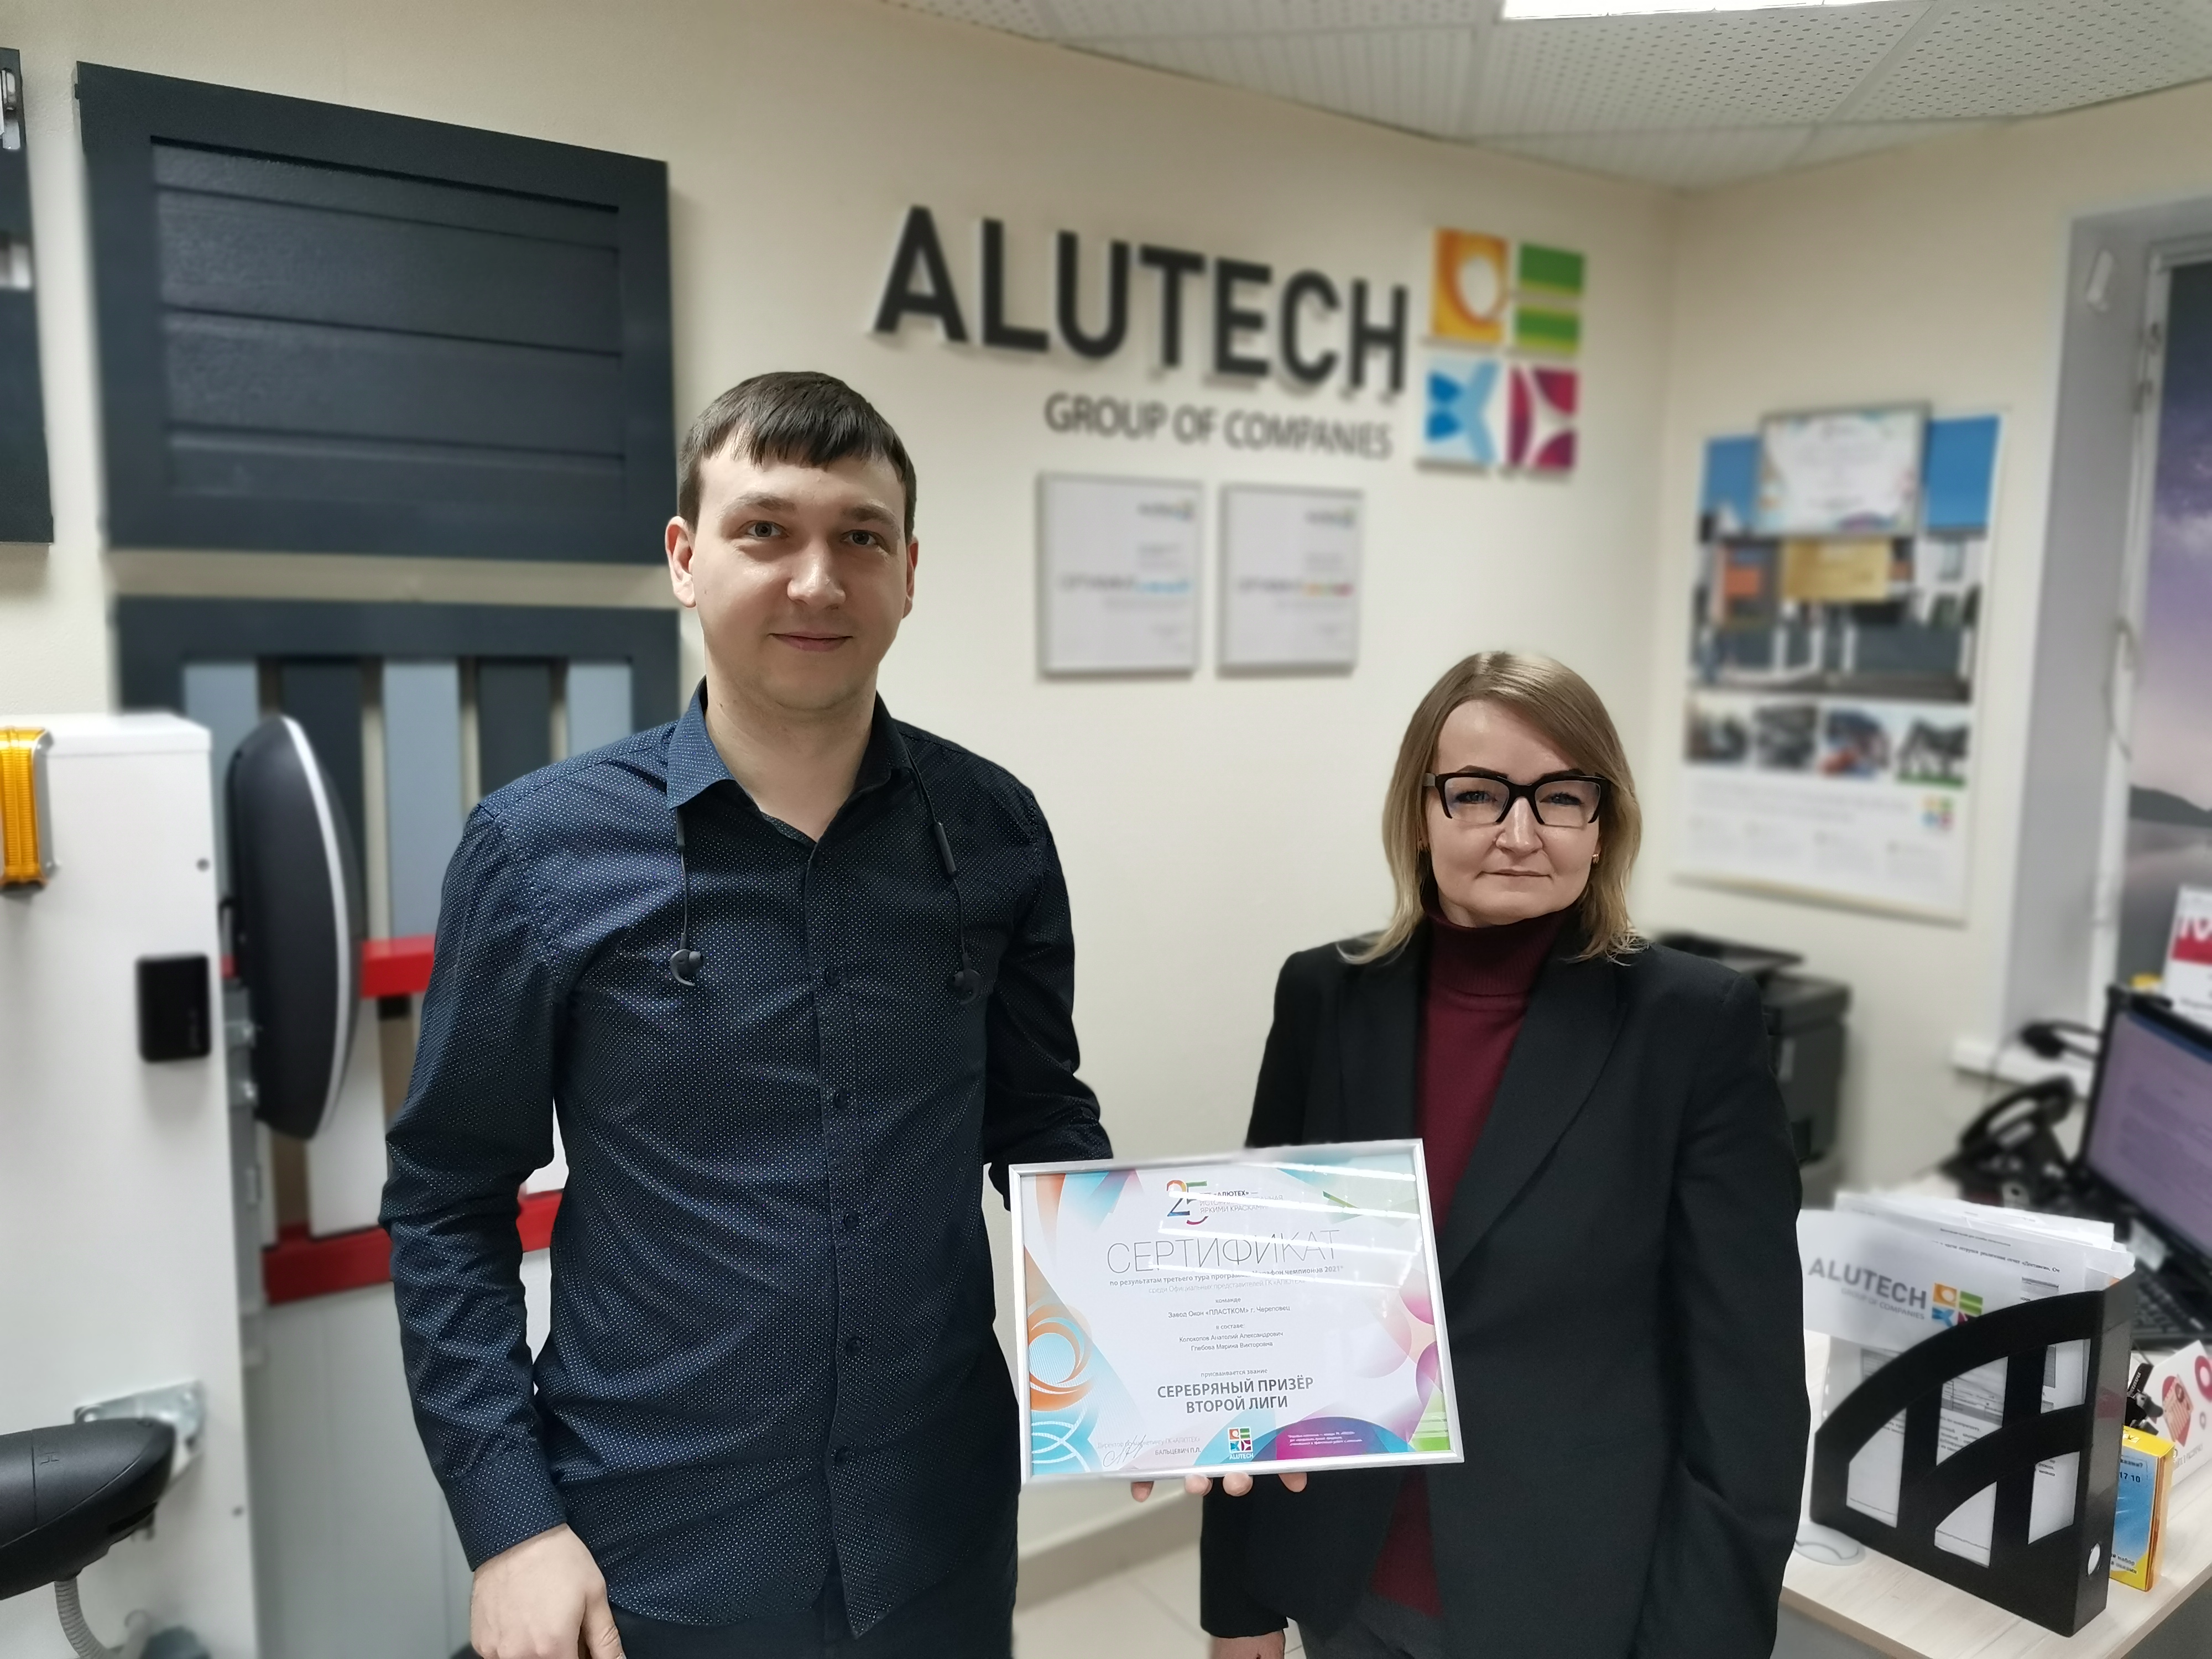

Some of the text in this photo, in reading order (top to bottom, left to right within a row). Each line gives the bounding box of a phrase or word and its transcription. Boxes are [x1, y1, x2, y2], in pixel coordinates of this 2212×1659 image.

[873, 205, 1408, 394] ALUTECH
[1044, 392, 1393, 461] GROUP OF COMPANIES
[1107, 1229, 1340, 1274] СЕРТИФИКАТ
[1120, 1277, 1162, 1287] результатам
[1164, 1275, 1193, 1284] третьего
[1168, 1284, 1212, 1292] Официальных
[1214, 1280, 1264, 1291] представителей
[1808, 1257, 1927, 1310] ALUTECH
[1841, 1287, 1924, 1320] GROUP OF COMPANIES
[1206, 1307, 1249, 1316] «ПЛАСТКОМ»
[1239, 1331, 1284, 1339] Александрович
[1201, 1370, 1246, 1378] присваивается
[1157, 1375, 1313, 1398] СЕРЕБРЯНЫЙ ПРИЗЁР
[1186, 1395, 1288, 1413] ВТОРОЙ ЛИГИ
[2131, 1475, 2141, 1483] 10
[2117, 1556, 2135, 1566] набор
